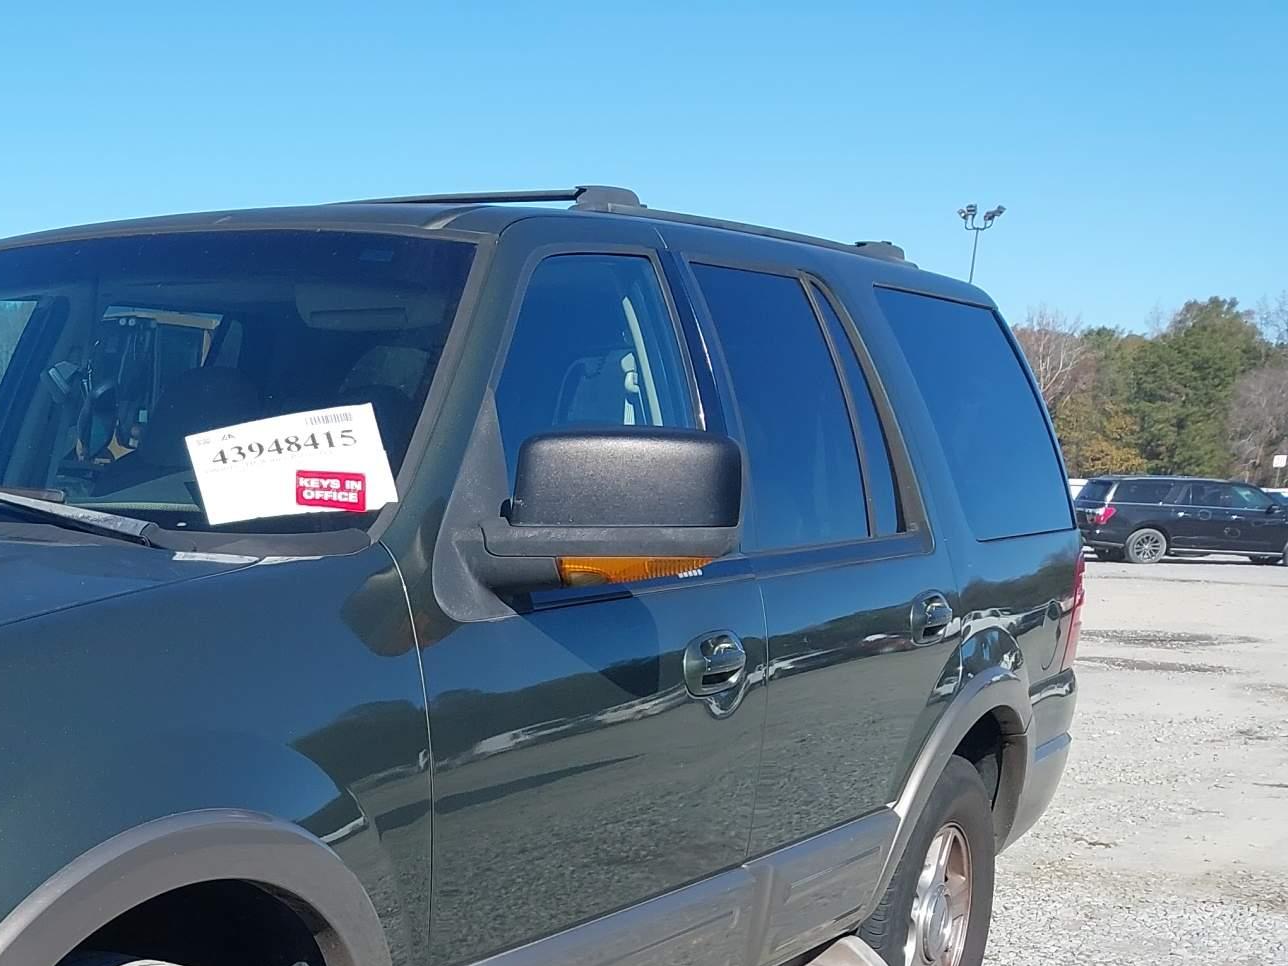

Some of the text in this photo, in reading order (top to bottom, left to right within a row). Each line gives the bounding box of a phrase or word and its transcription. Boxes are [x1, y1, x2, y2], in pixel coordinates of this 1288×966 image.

[212, 429, 357, 465] 43948415
[298, 477, 362, 491] KEYS IN
[302, 489, 359, 504] OFFICE
